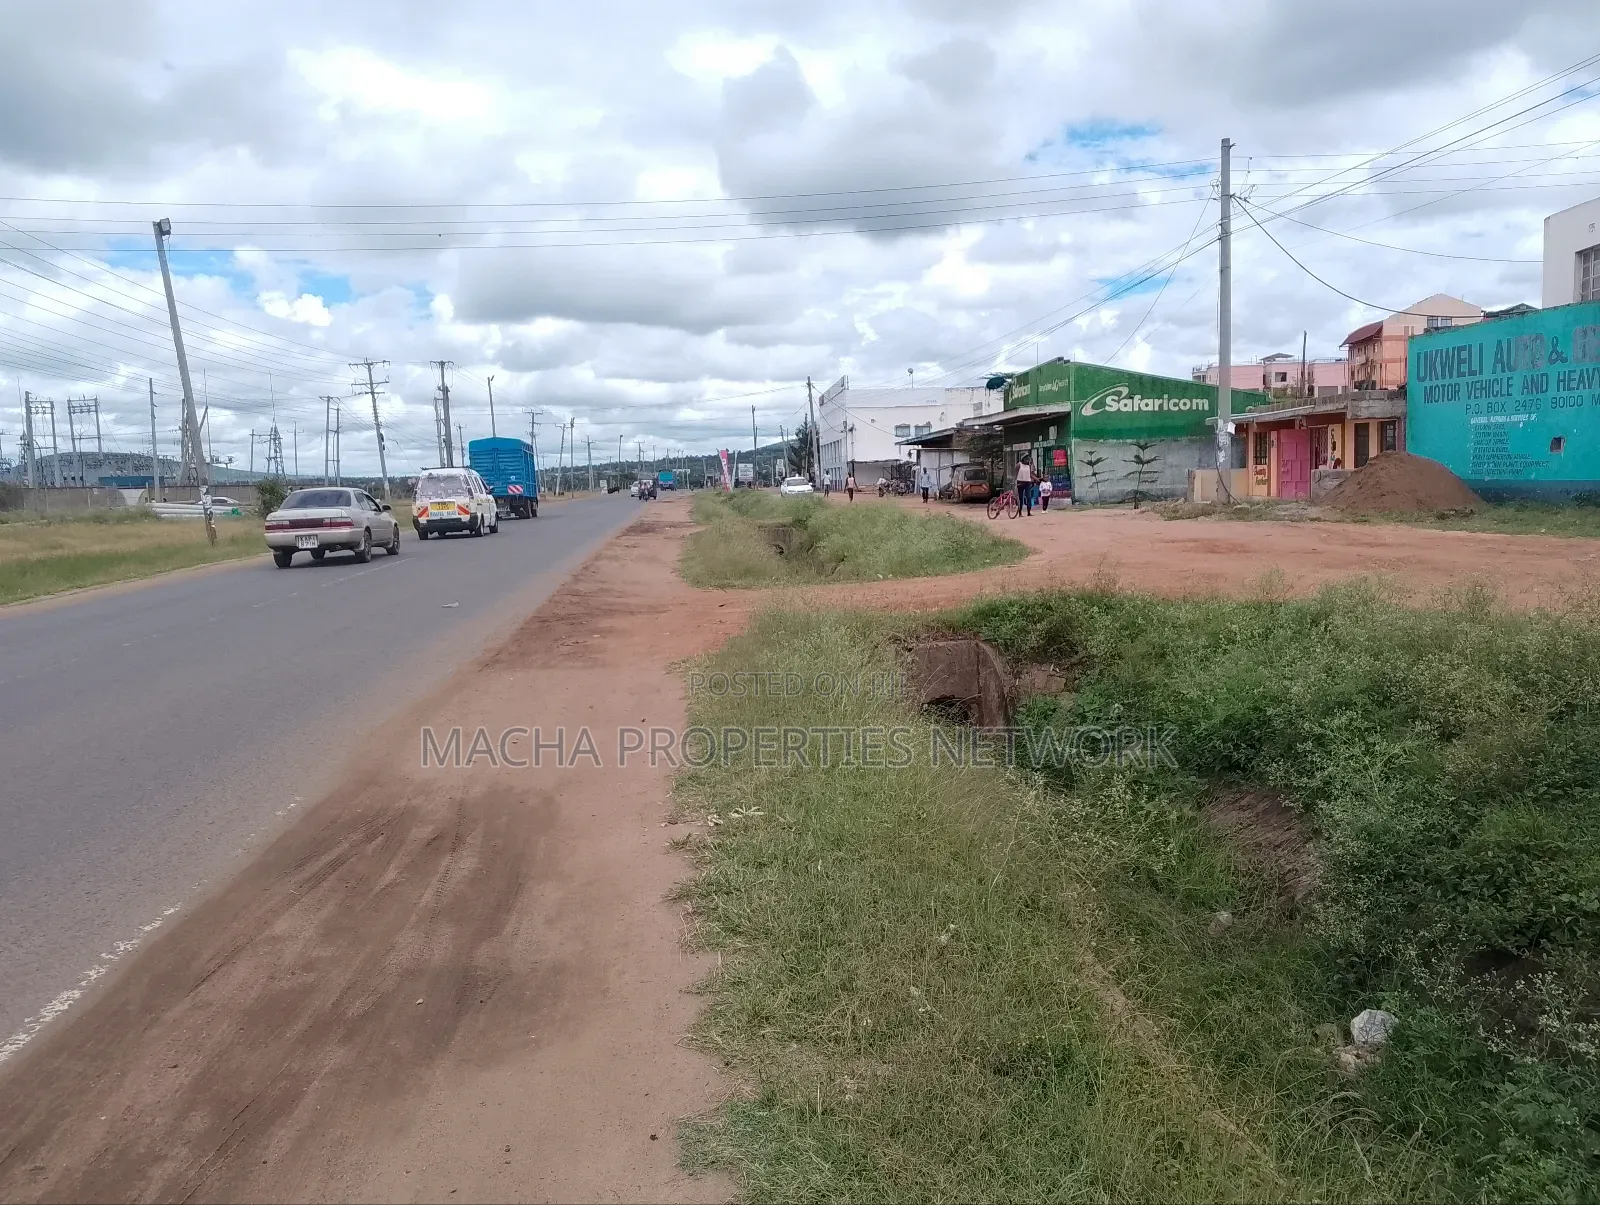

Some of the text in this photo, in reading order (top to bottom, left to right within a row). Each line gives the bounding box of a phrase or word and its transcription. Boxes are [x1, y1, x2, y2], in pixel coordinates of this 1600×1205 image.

[1416, 342, 1484, 382] UKWELI
[1548, 336, 1569, 365] &
[1424, 383, 1461, 404] MOTOR
[1466, 376, 1514, 400] VEHICLE
[1521, 372, 1549, 395] AND
[1105, 394, 1209, 412] Safaricom
[1487, 401, 1507, 413] BOX
[1551, 395, 1584, 409] 90100
